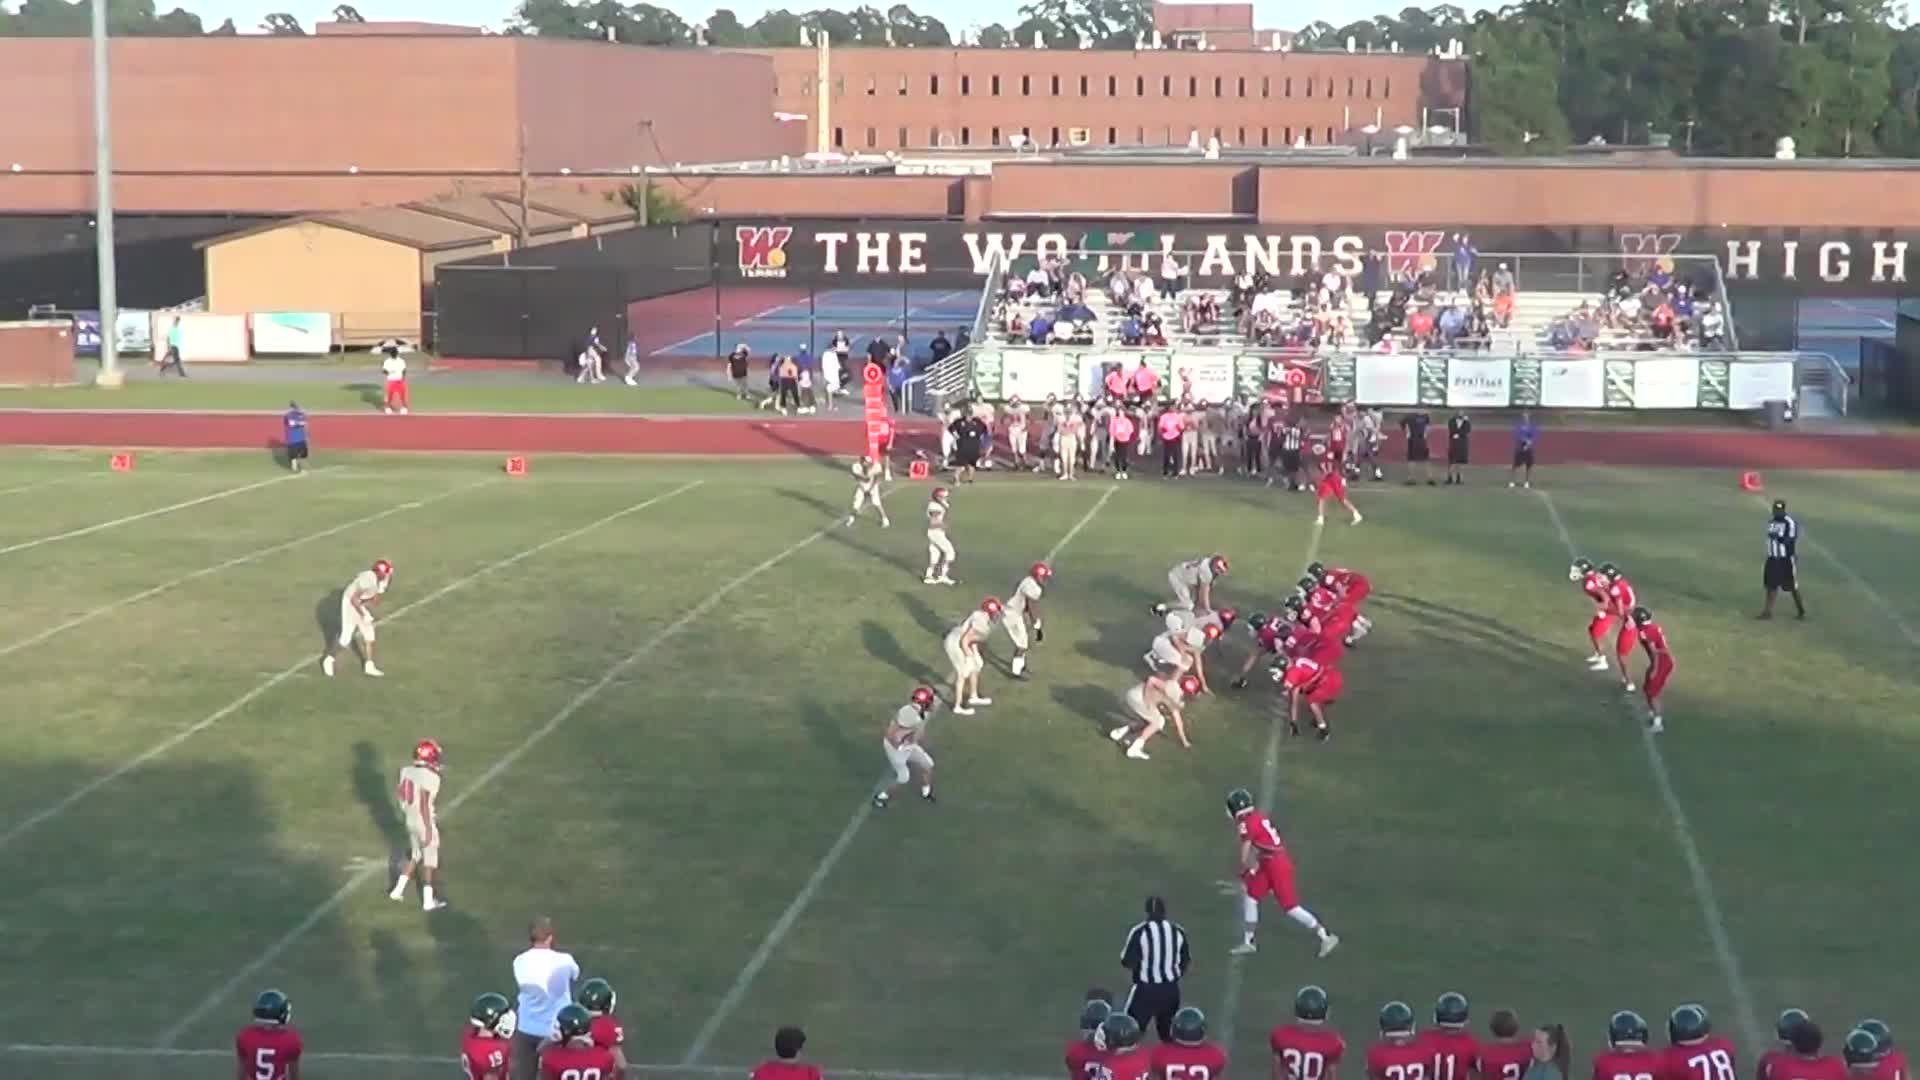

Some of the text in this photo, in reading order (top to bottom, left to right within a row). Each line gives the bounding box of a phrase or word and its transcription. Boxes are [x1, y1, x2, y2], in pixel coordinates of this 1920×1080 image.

[815, 232, 1364, 276] THE WOLANDS
[1725, 240, 1909, 282] HIGH
[255, 1047, 276, 1080] 5
[1282, 1047, 1324, 1080] 30
[1688, 1049, 1738, 1080] 78
